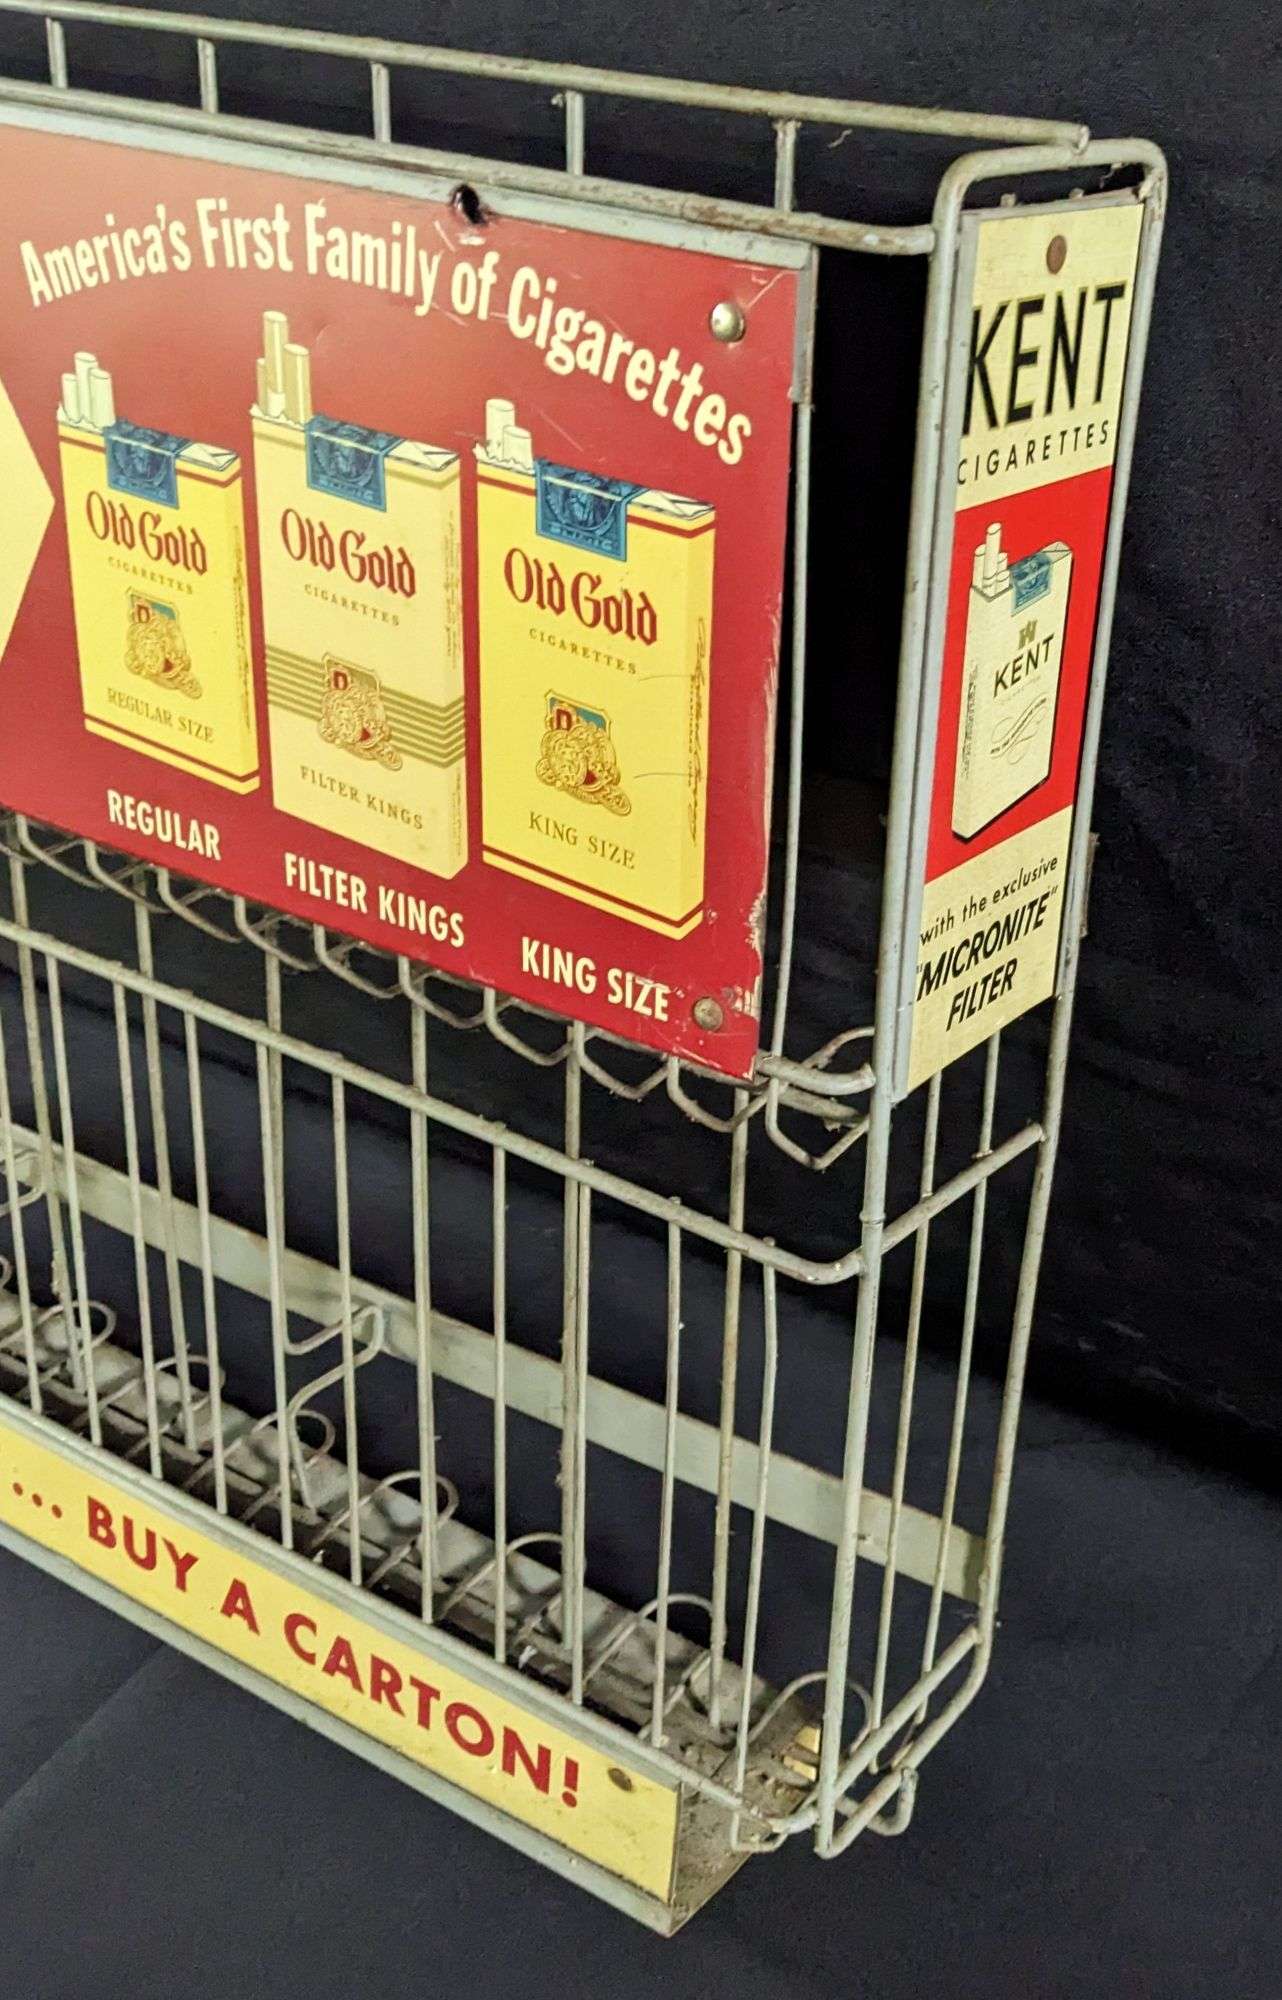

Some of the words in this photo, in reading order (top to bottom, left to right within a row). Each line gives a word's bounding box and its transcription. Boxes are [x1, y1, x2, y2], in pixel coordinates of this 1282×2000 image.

[20, 203, 192, 308] America's
[196, 198, 293, 272] First
[304, 202, 441, 316] Family
[451, 251, 500, 320] of
[507, 266, 752, 465] Cigarettes
[962, 280, 1127, 436] KENT
[957, 420, 1109, 485] CIGARETTES
[86, 490, 135, 550] Old
[139, 511, 208, 576] Gold
[280, 508, 334, 573] Old
[339, 529, 417, 599] Gold
[108, 556, 194, 595] CIGARETTES
[304, 583, 400, 627] CIGARETTES
[503, 547, 566, 616] Old
[570, 571, 658, 646] Gold
[529, 628, 638, 675] CIGARETTES
[994, 632, 1054, 698] KENT
[107, 687, 173, 728] REGULAR
[178, 715, 214, 744] SIZE
[107, 788, 222, 861] REGULAR
[300, 766, 361, 805] FILTER
[366, 793, 423, 830] KINGS
[528, 810, 578, 848] KING
[587, 831, 636, 871] SIZE
[284, 852, 368, 914] FILTER
[378, 885, 465, 948] KINGS
[919, 908, 954, 946] with
[962, 896, 987, 923] the
[992, 856, 1058, 905] exclusive
[521, 936, 597, 995] KING
[607, 967, 669, 1023] SIZE
[916, 885, 1058, 1002] "MICRONITE"
[946, 958, 1018, 1032] FILTER
[87, 1496, 199, 1593] BUY
[219, 1579, 260, 1636] A
[283, 1612, 579, 1808] CARTON!
